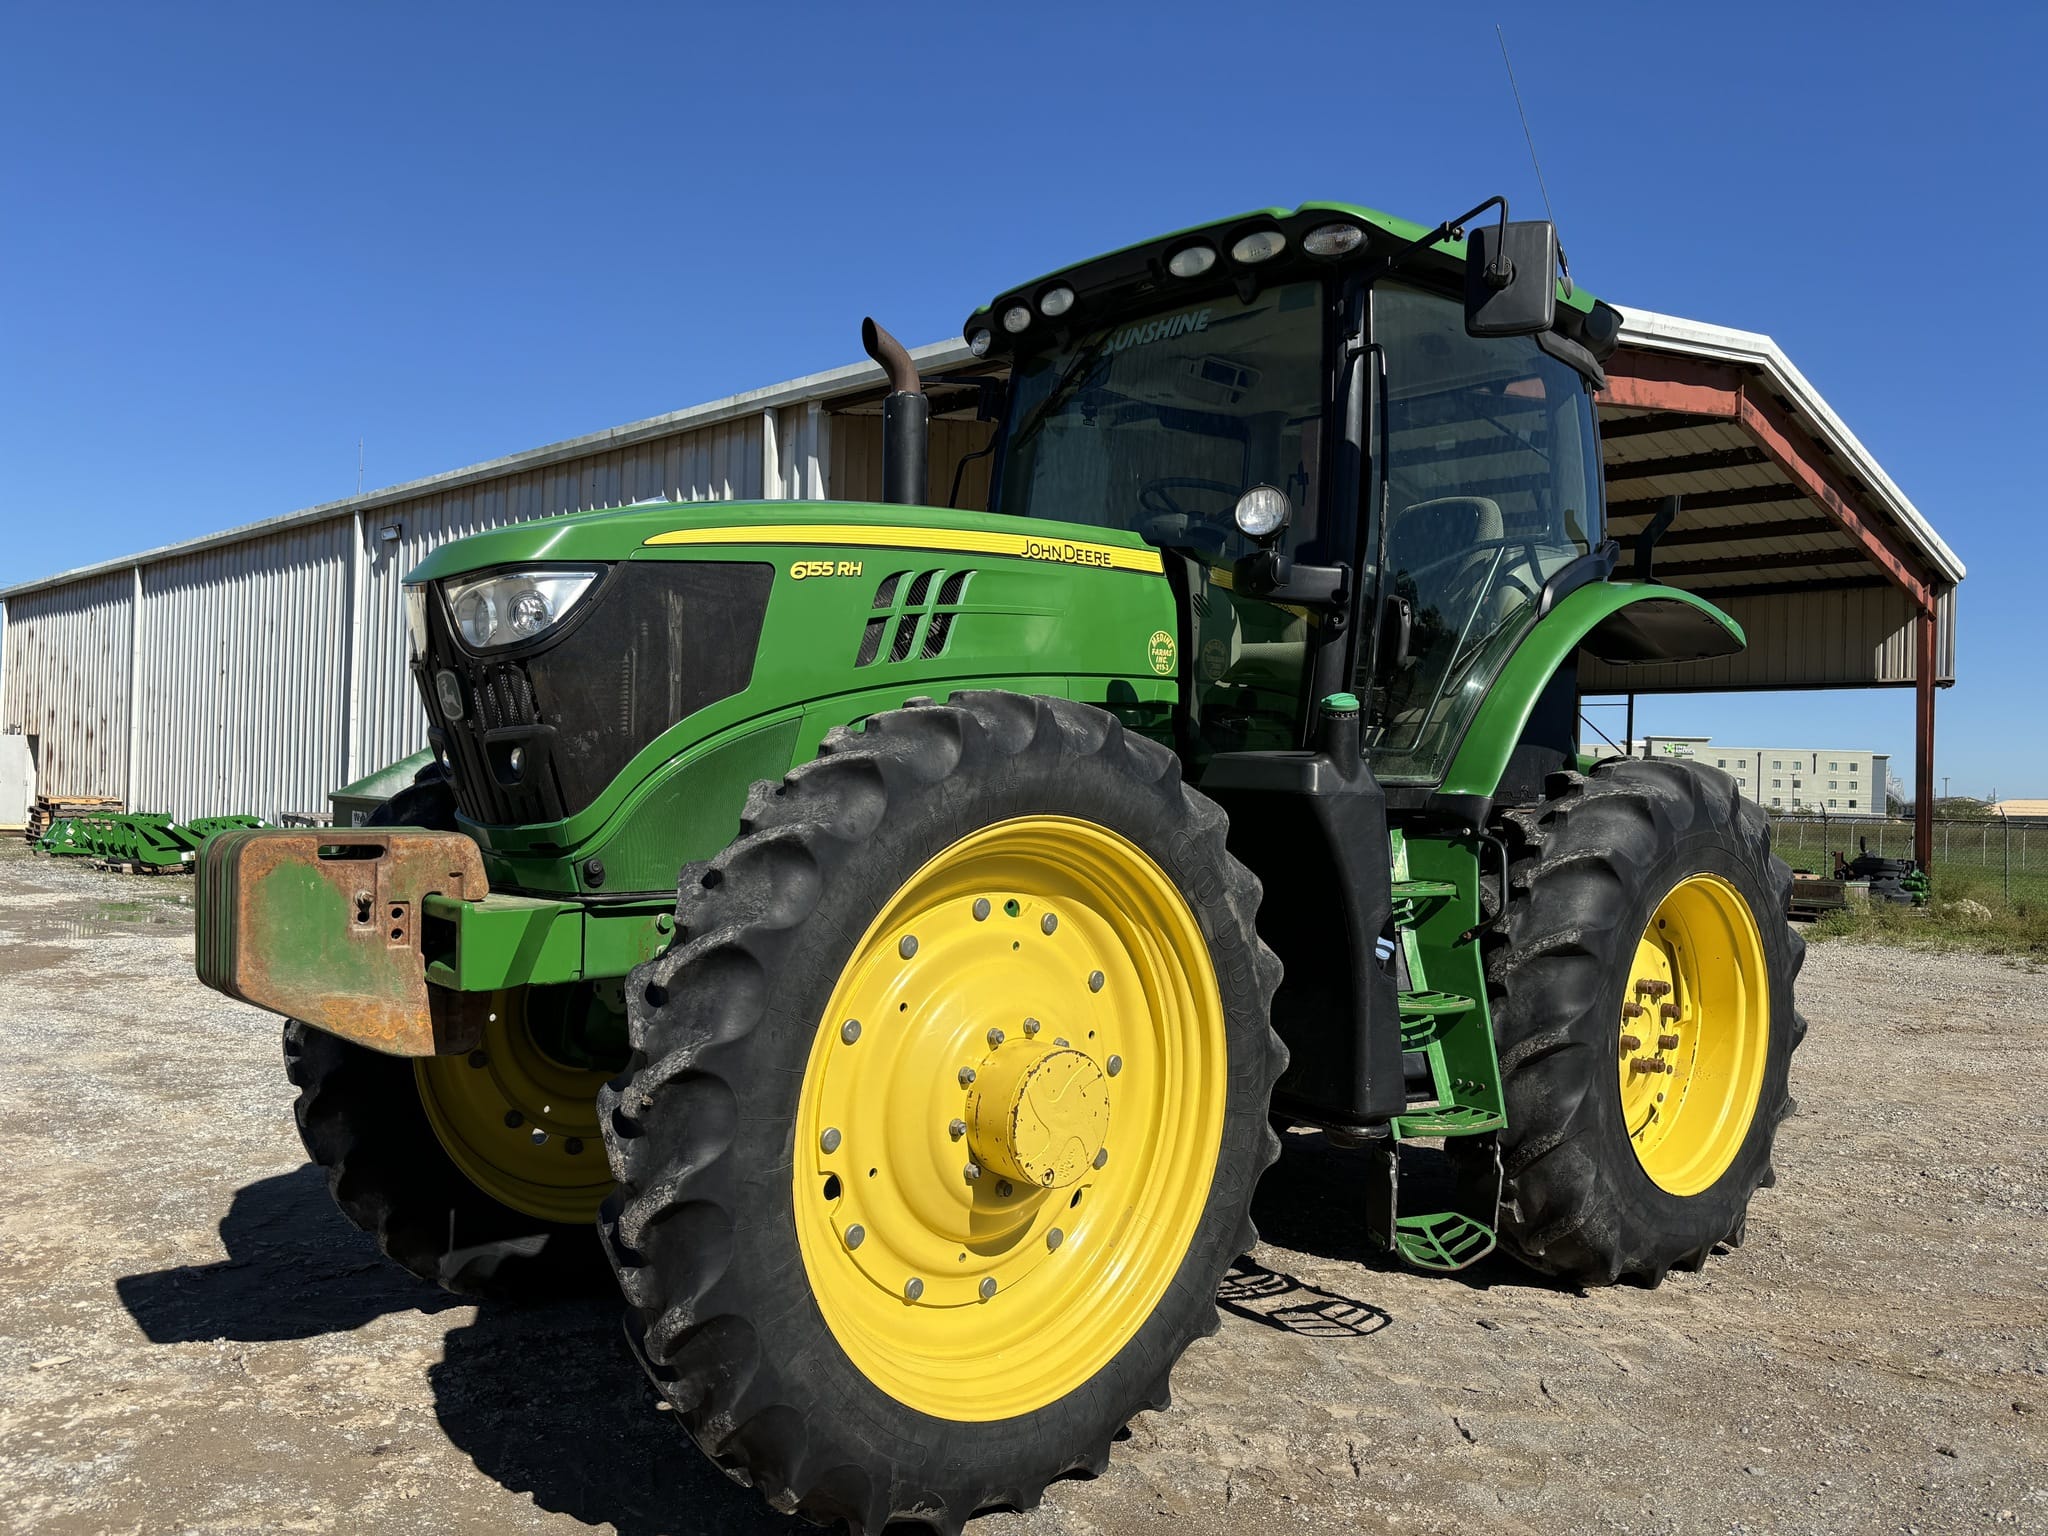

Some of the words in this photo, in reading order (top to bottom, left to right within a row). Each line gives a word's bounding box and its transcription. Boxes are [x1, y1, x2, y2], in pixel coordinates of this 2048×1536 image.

[1100, 308, 1212, 356] SUNSHINE
[1021, 539, 1062, 559] JOHN
[1063, 543, 1112, 565] DEERE
[789, 561, 835, 580] 6155
[837, 561, 863, 577] RH
[1151, 648, 1173, 657] FARMS
